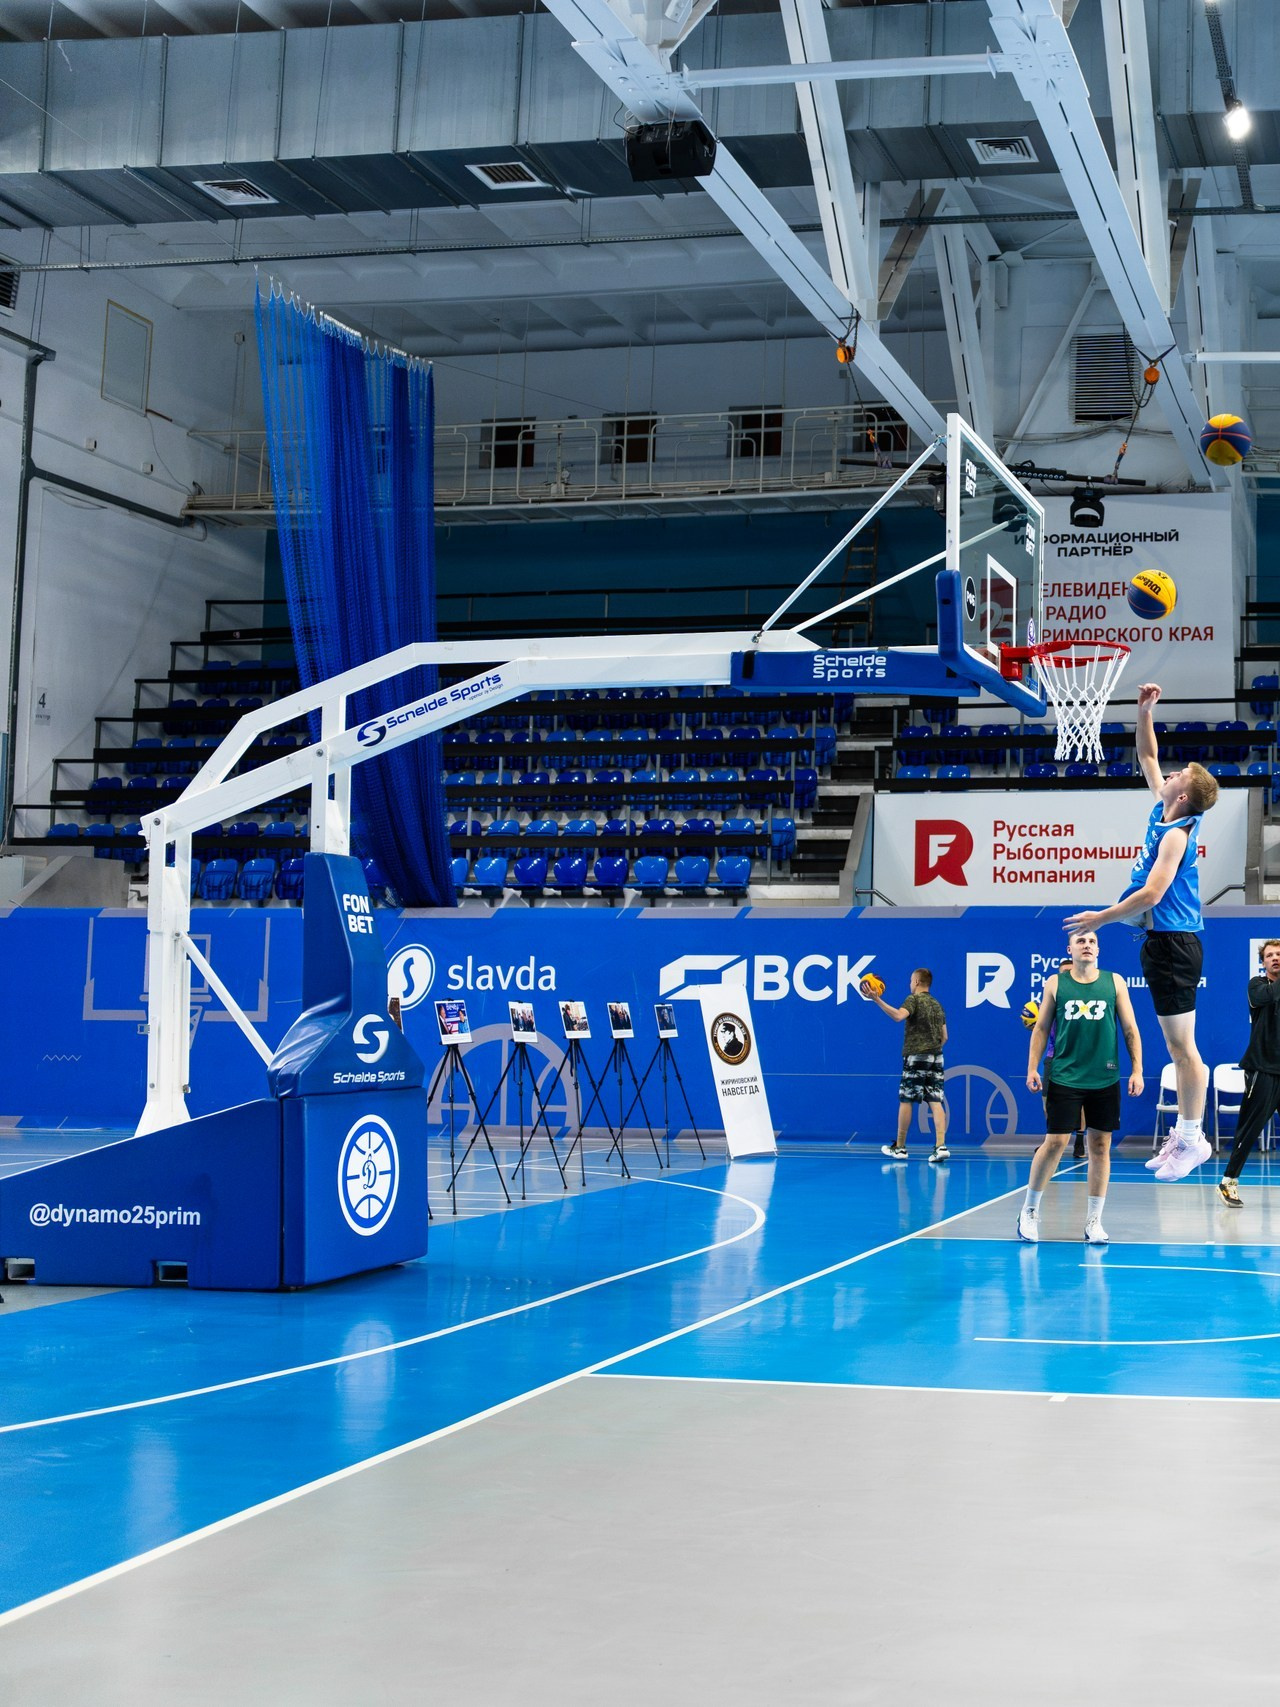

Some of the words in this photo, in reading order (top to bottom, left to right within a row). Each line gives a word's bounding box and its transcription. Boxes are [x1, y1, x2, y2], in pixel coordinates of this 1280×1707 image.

[1014, 529, 1179, 545] ИОРМАЦИОННЫЙ
[1057, 543, 1133, 557] ПАРТНЁР
[1046, 605, 1107, 623] РАДИО
[1042, 627, 1163, 643] РИМОРСКОГО
[1168, 625, 1214, 642] КРАЯ
[813, 654, 887, 666] Schelde
[812, 666, 886, 681] Sports
[449, 673, 502, 702] Sports
[39, 692, 46, 708] 4
[992, 819, 1075, 842] Русская
[992, 866, 1096, 884] Компания
[342, 893, 370, 914] FON
[347, 914, 374, 934] BET
[447, 955, 557, 991] slavda
[753, 954, 877, 1006] ВСК
[333, 1072, 377, 1084] Schelde
[377, 1070, 405, 1084] Sports
[721, 1084, 760, 1097] НАВСЕГДА
[29, 1202, 201, 1229] @dynamo25prim
